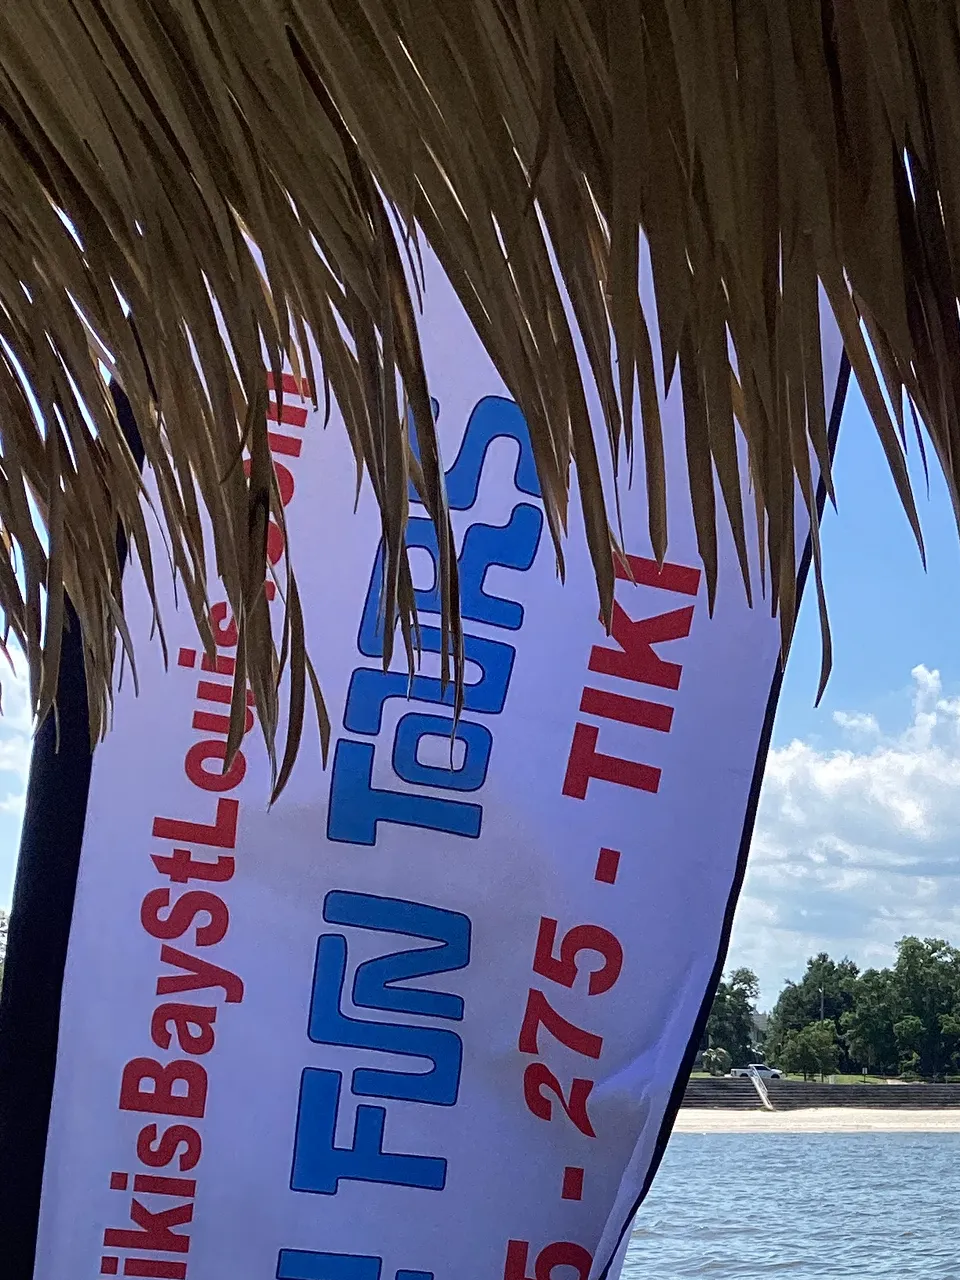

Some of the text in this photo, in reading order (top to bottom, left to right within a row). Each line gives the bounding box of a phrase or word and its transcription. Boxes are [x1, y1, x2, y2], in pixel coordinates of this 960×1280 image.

[562, 551, 701, 801] TIKI
[290, 889, 472, 1196] FUN
[518, 915, 624, 1138] 275
